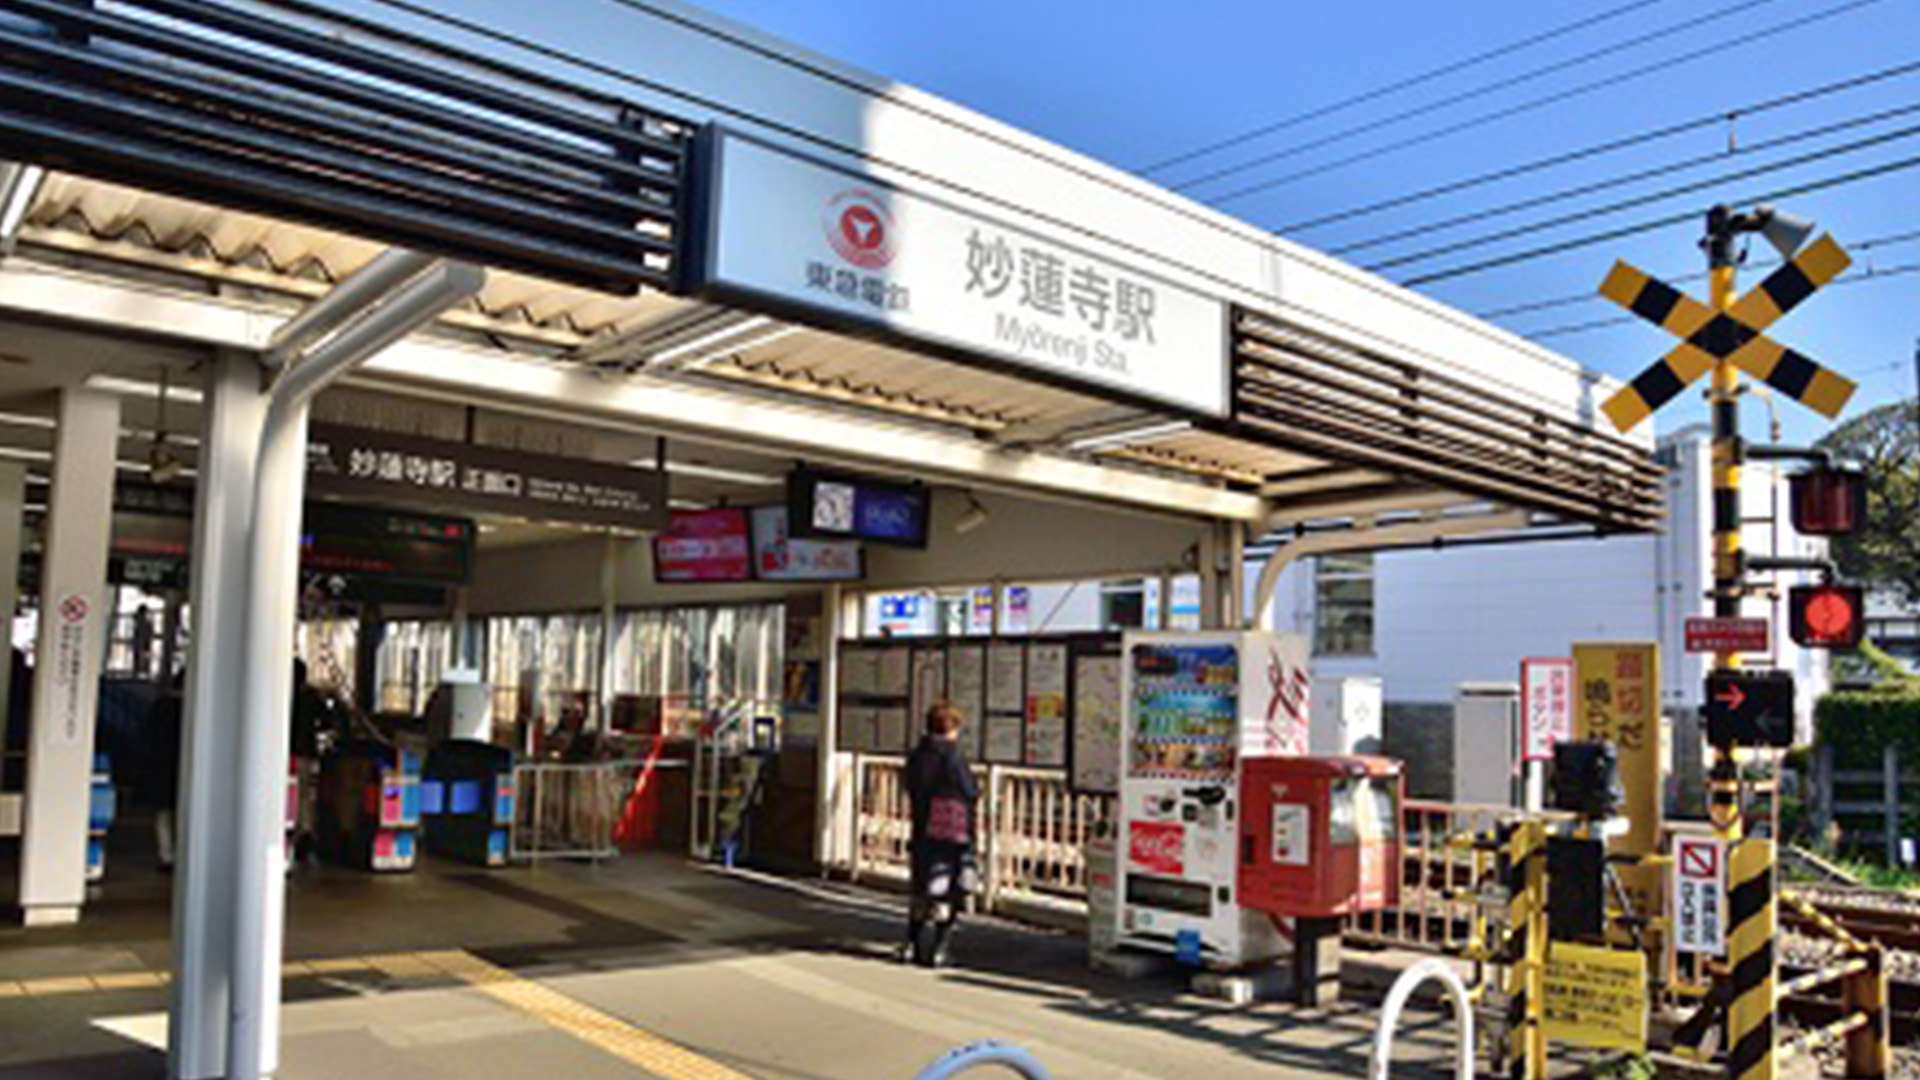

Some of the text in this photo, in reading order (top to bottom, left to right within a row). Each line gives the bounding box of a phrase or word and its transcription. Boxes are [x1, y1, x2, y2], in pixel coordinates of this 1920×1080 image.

[965, 228, 1157, 346] 妙蓮寺駅
[350, 449, 456, 489] 妙蓮寺駅
